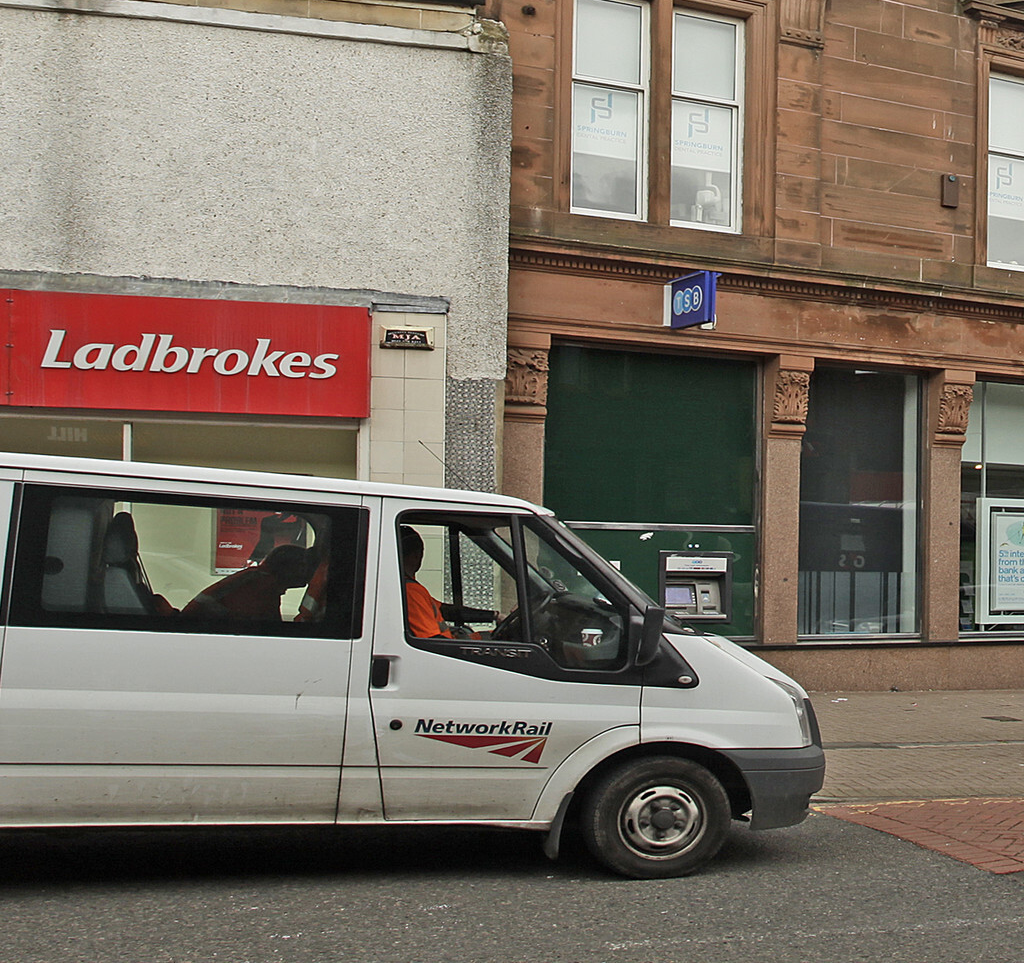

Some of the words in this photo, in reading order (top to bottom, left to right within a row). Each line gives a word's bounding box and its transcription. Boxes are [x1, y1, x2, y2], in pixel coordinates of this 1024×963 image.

[577, 124, 627, 138] SPRINGBURN
[674, 139, 724, 151] SPRINGBURN
[989, 191, 1024, 202] PRINGBURN
[675, 290, 700, 309] TSB
[392, 333, 421, 341] MJA
[40, 329, 340, 380] Ladbrokes
[998, 558, 1018, 566] from
[998, 566, 1018, 574] bank
[998, 574, 1019, 583] that's
[460, 646, 532, 658] TRANSIT
[414, 718, 553, 736] NetworkRail
